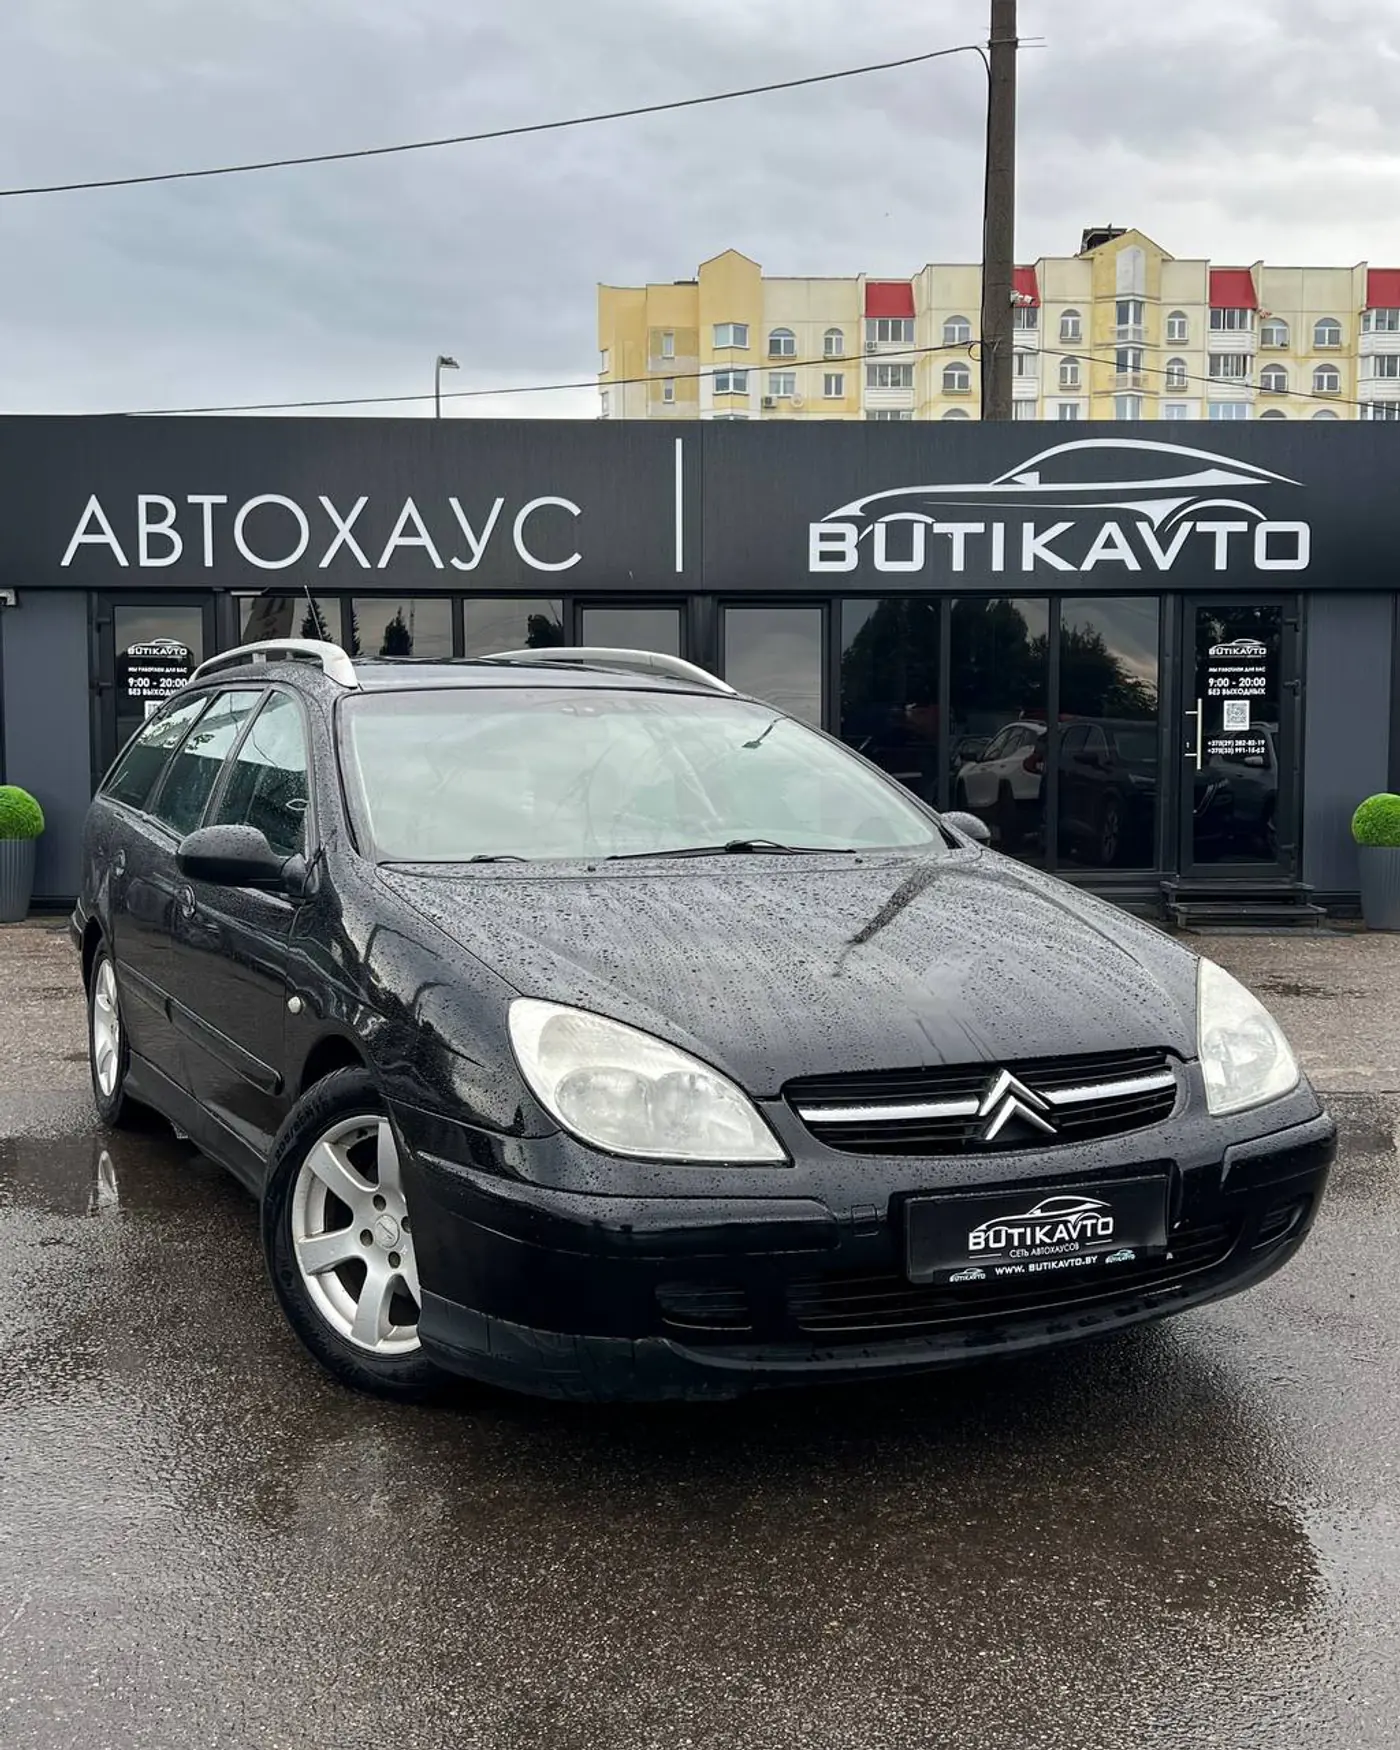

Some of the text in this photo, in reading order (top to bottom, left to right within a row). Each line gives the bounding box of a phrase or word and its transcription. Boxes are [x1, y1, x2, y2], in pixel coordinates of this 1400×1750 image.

[60, 493, 583, 572] АВТОХАУС
[808, 519, 1311, 574] BUTIKAVTO
[127, 647, 188, 656] BUTIKAVTO
[1208, 647, 1267, 655] BUTIKAVTO
[128, 677, 150, 687] 9:00
[159, 677, 188, 688] 20:00
[1208, 677, 1230, 687] 9:00
[1238, 677, 1266, 687] 20:00
[128, 688, 142, 696] БЕЗ
[1208, 688, 1266, 696] БЕЗ ВЫХОДНЫХ
[968, 1216, 1114, 1251] BUTIKAVTO
[1009, 1241, 1080, 1258] СЕТЬ АВТОХАУСОВ
[994, 1255, 1099, 1276] WWW. BUTIKAVTO.BY
